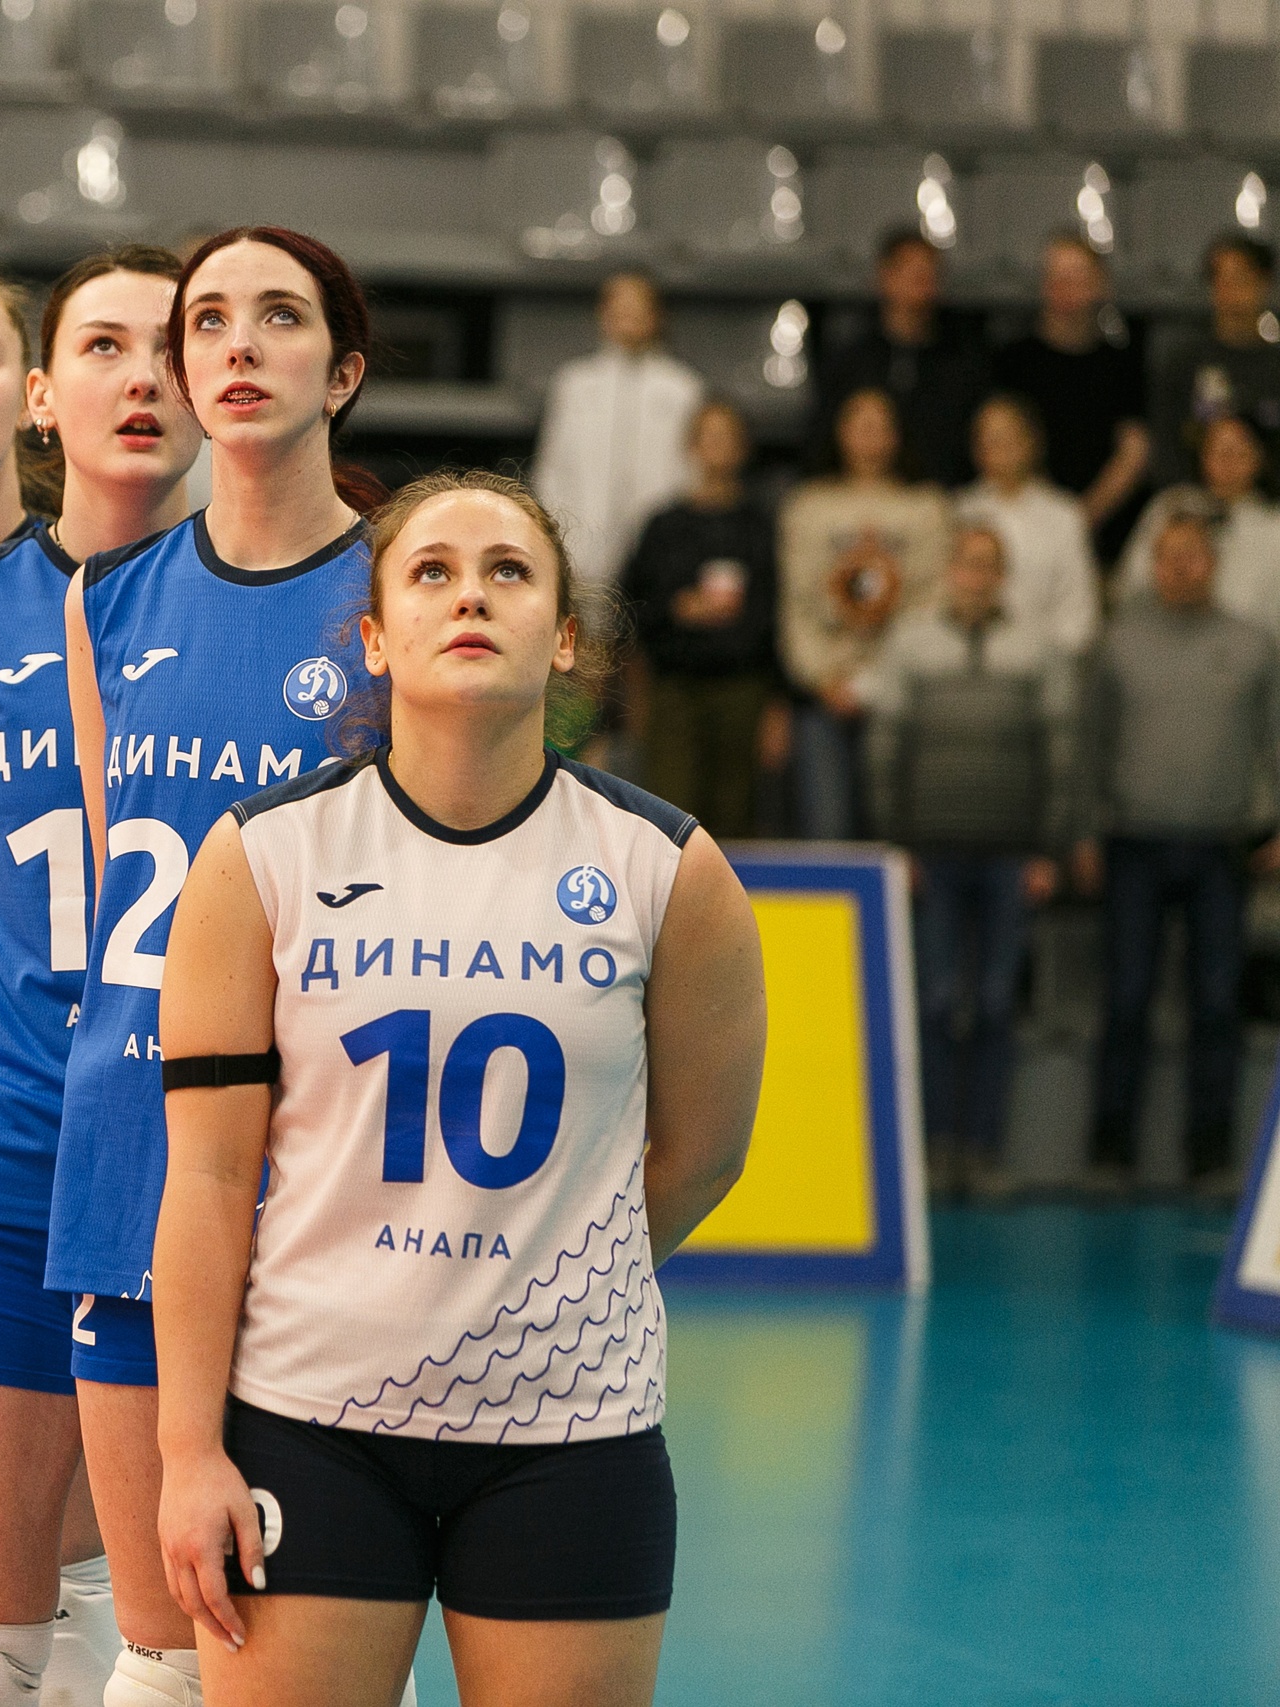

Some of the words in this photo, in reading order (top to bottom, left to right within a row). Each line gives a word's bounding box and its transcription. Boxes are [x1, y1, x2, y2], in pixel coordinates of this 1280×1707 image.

[107, 734, 344, 789] ДИНАМ
[6, 808, 87, 972] 1
[101, 818, 189, 990] 2
[301, 937, 618, 992] ДИНАМО
[339, 1009, 566, 1190] 10
[375, 1224, 512, 1260] АНАПА
